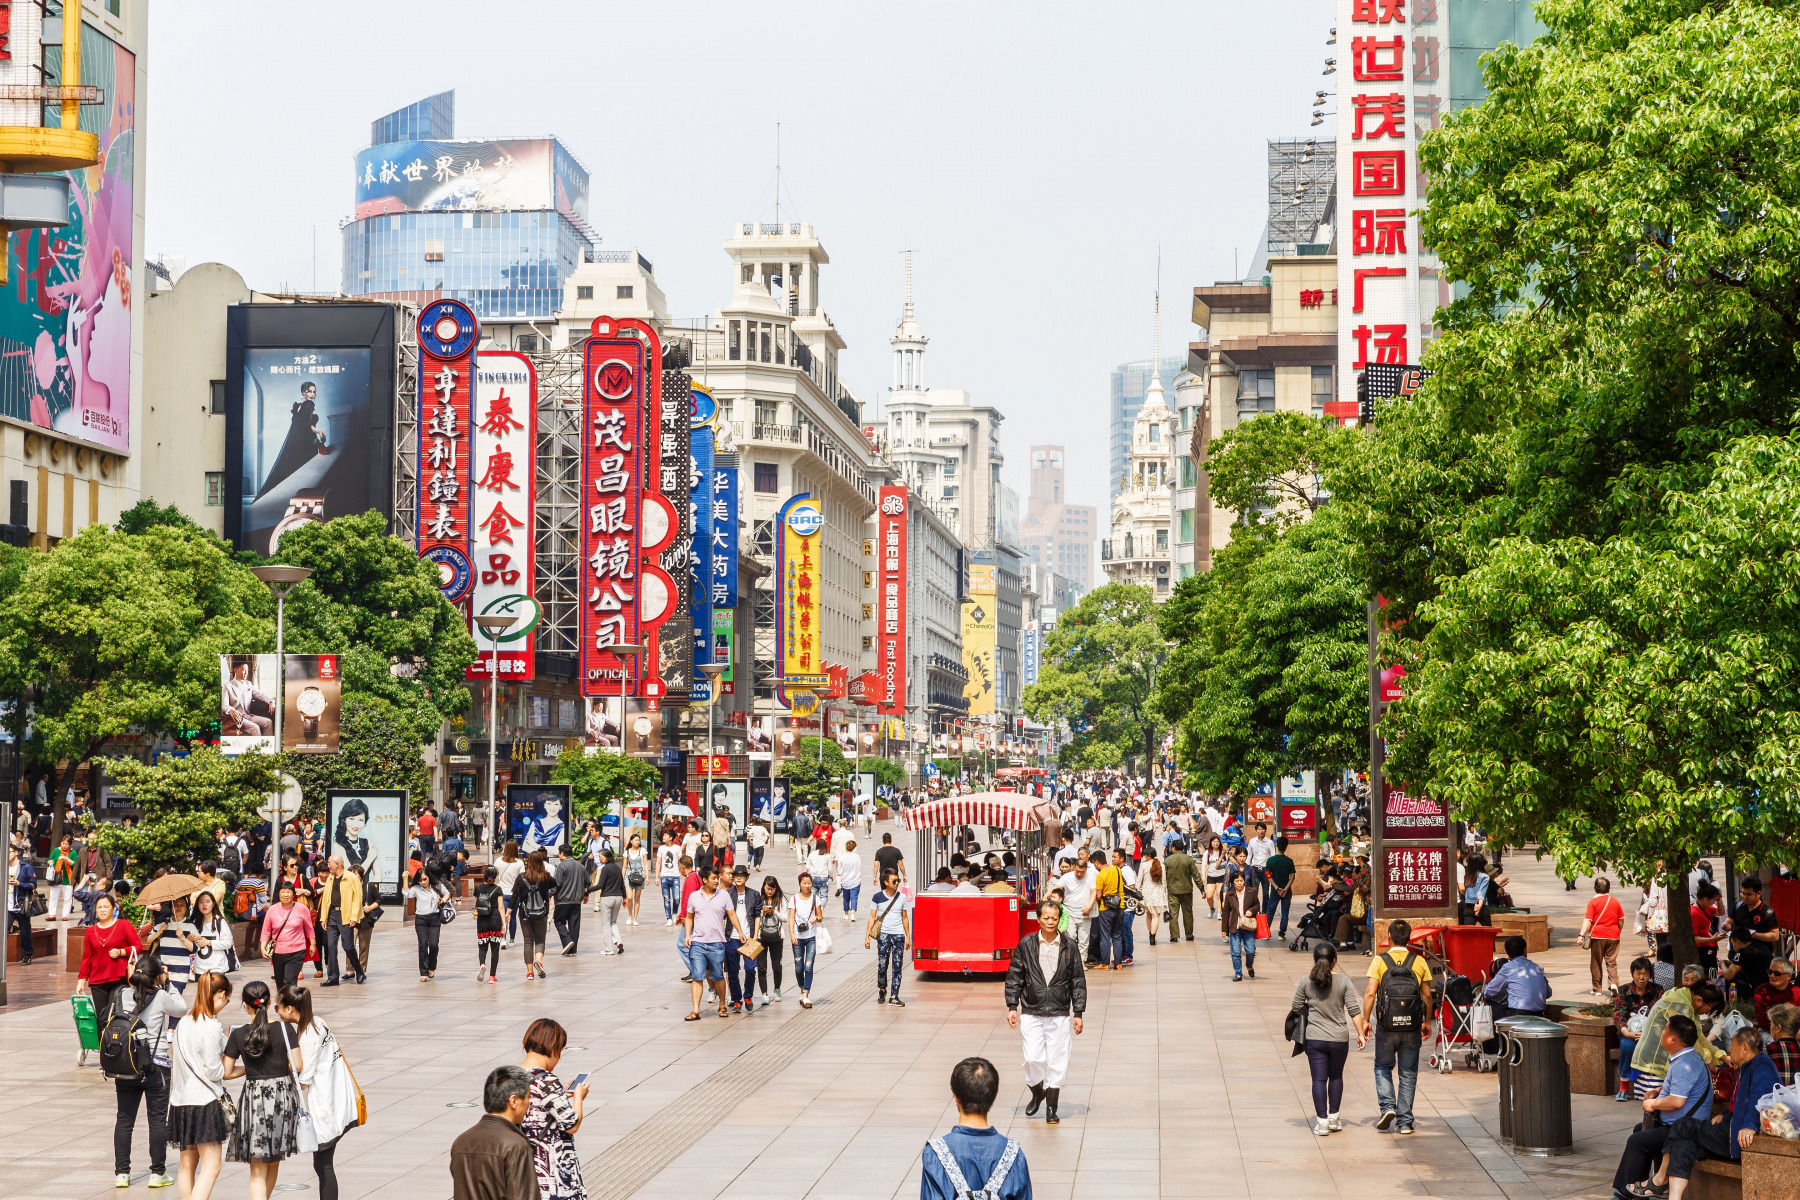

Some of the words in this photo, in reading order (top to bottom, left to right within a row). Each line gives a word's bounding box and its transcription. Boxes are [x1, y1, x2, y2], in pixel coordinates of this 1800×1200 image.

[1300, 289, 1338, 306] 新
[440, 305, 453, 313] XII
[421, 324, 432, 332] IX
[462, 325, 472, 333] III
[441, 345, 452, 353] VI
[478, 372, 508, 382] SINCE
[509, 372, 528, 382] 1914
[478, 387, 526, 586] 泰康食品
[589, 407, 634, 650] 茂昌眼镜公司
[886, 520, 899, 634] 上海市第一食品商店
[887, 640, 897, 660] First
[588, 669, 632, 680] OPTICAL
[110, 800, 135, 808] Pandora
[1388, 851, 1443, 867] 纤体名牌
[1388, 867, 1443, 882] 香港直营
[1398, 884, 1420, 893] 3126
[1421, 884, 1443, 893] 2666
